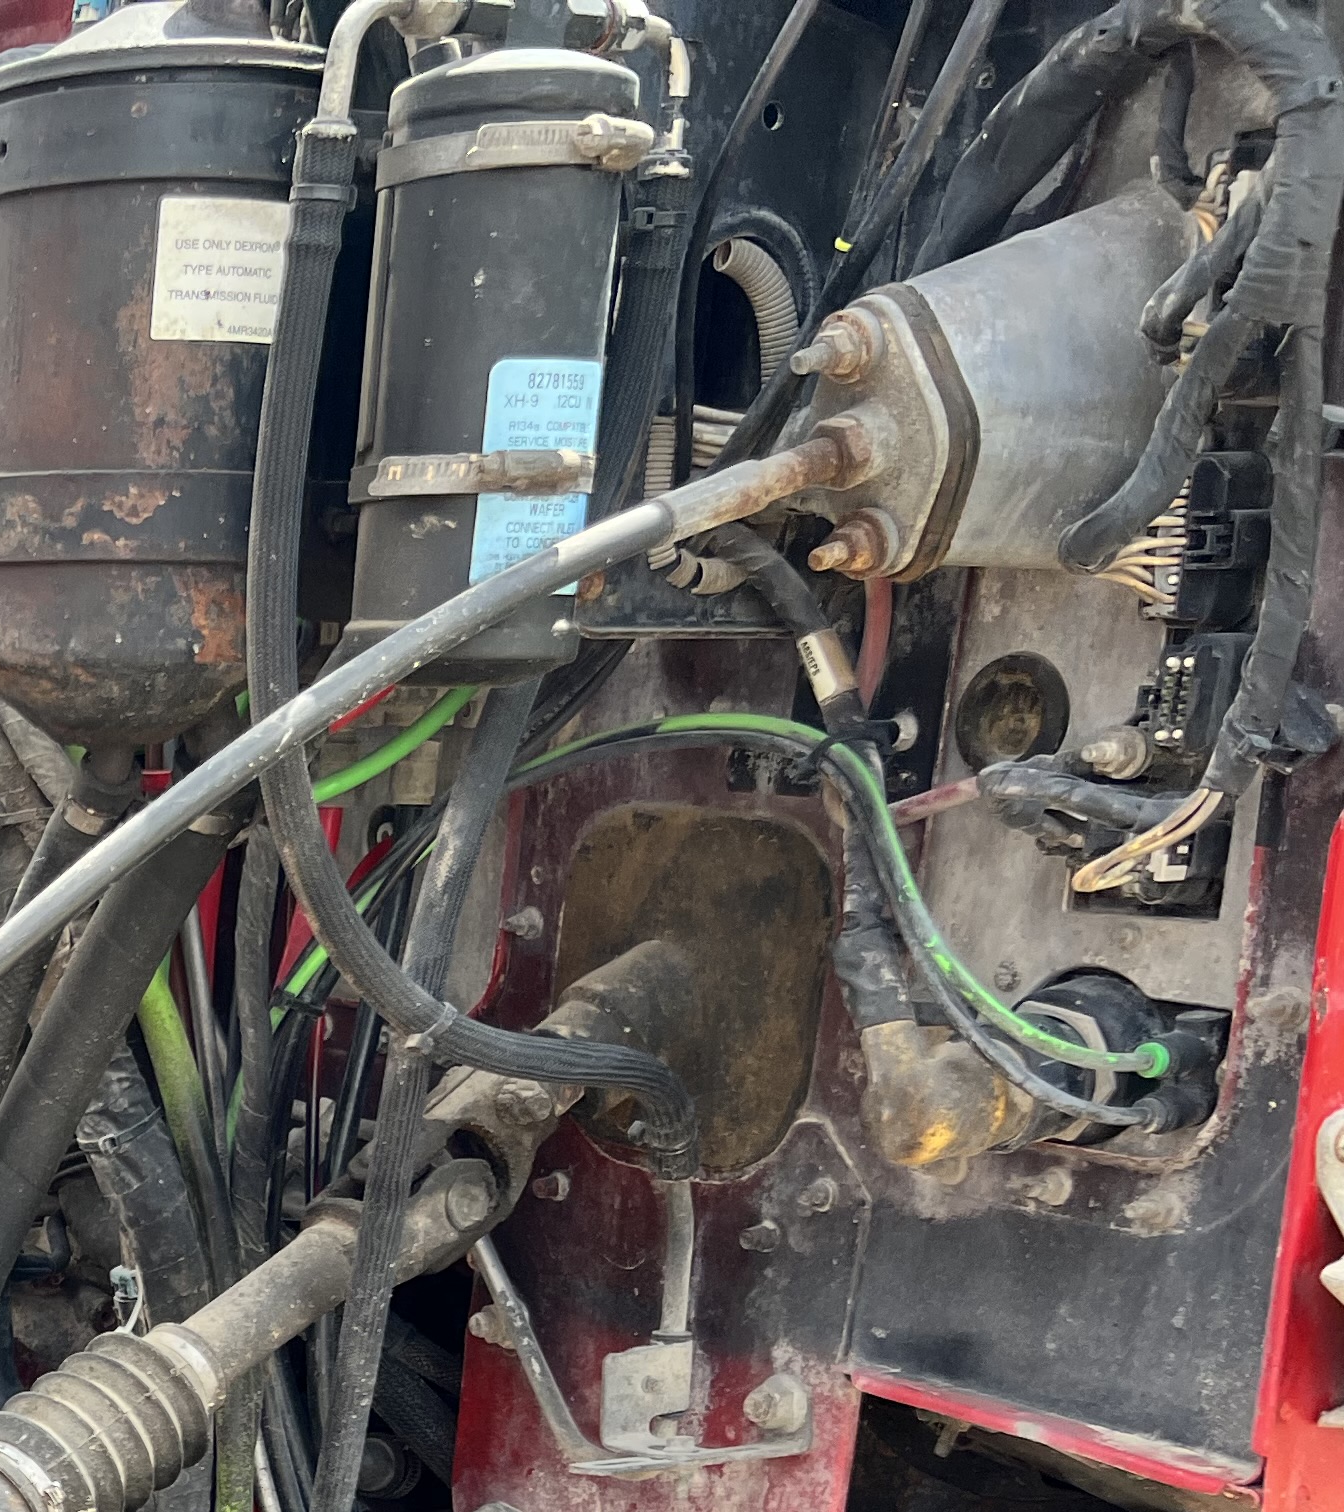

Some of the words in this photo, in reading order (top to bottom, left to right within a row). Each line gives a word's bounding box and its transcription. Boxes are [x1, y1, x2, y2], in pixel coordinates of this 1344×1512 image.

[175, 238, 199, 250] USE
[202, 238, 231, 251] ONLY
[183, 264, 212, 276] TYPE
[215, 265, 272, 279] AUTOMATIC
[168, 289, 251, 303] TRANSMISSION
[253, 293, 278, 305] FLUID
[527, 372, 585, 391] 82781559
[504, 394, 539, 409] XH-9
[507, 436, 549, 448] SERVICE
[529, 503, 565, 517] WAFER
[505, 521, 552, 535] CONNECT
[505, 537, 520, 549] TO
